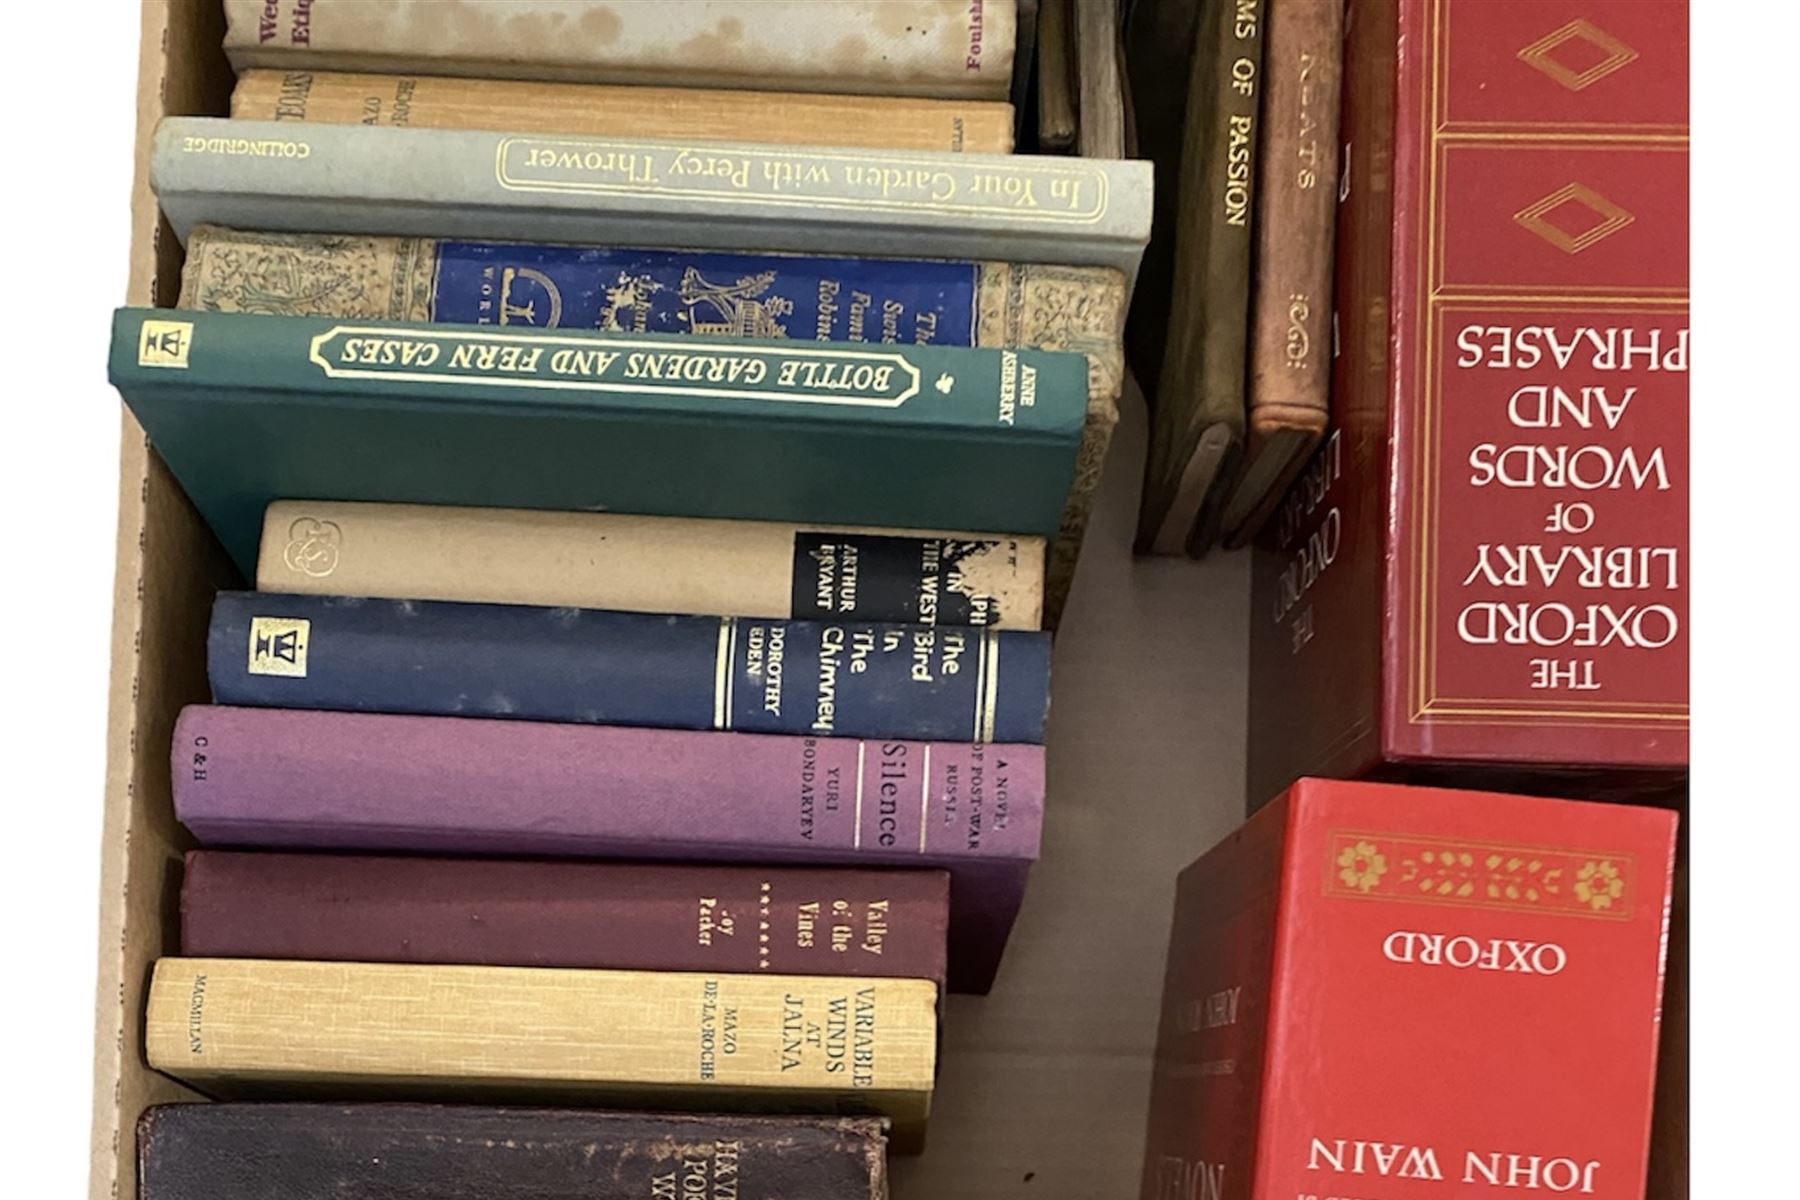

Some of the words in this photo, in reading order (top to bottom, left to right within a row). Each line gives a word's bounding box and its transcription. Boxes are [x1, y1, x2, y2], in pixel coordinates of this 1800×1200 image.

[260, 0, 278, 44] We
[1232, 58, 1255, 96] OF
[362, 96, 381, 126] AZO
[183, 136, 310, 158] COLLINGRIDGE
[524, 149, 658, 183] Thrower
[669, 150, 751, 185] Percy
[763, 162, 830, 189] with
[846, 166, 955, 197] Garden
[970, 174, 1038, 206] Your
[1225, 115, 1251, 226] PASSION
[1050, 180, 1081, 209] In
[478, 266, 494, 325] WORL
[340, 338, 440, 367] CASES
[448, 344, 544, 374] FERN
[551, 349, 619, 378] AND
[624, 352, 767, 385] GARDENS
[1457, 326, 1689, 371] PHRASES
[779, 361, 894, 392] BOTTLE
[1021, 364, 1036, 407] ANNE
[1507, 386, 1638, 429] AND
[1470, 444, 1671, 490] WORDS
[1544, 503, 1595, 533] OF
[816, 544, 836, 610] BRYANT
[839, 544, 858, 612] ARTHUR
[1463, 544, 1680, 589] LIBRARY
[919, 576, 940, 628] WEST
[1457, 603, 1679, 648] OXFORD
[747, 627, 764, 676] EDEN
[765, 627, 785, 716] DOROTHY
[851, 629, 875, 674] The
[912, 631, 936, 682] Bird
[942, 631, 965, 675] The
[812, 627, 845, 730] Chimney
[1531, 659, 1601, 690] THE
[194, 752, 207, 766] &
[195, 736, 208, 747] C
[193, 768, 207, 781] H
[996, 759, 1009, 769] A
[826, 767, 840, 812] YURI
[879, 743, 907, 847] Silence
[968, 767, 983, 850] POST-WAR
[798, 902, 820, 948] Vines
[832, 926, 853, 952] the
[861, 900, 889, 955] Valley
[1384, 931, 1567, 975] OXFORD
[190, 975, 207, 1054] MACMILLAN
[723, 1008, 737, 1055] MAZO
[781, 993, 804, 1072] JALNA
[807, 1022, 821, 1048] AT
[826, 997, 848, 1073] WINDS
[853, 987, 876, 1088] VARIABLE
[1307, 1138, 1442, 1181] WAIN
[1463, 1152, 1601, 1193] JOHN
